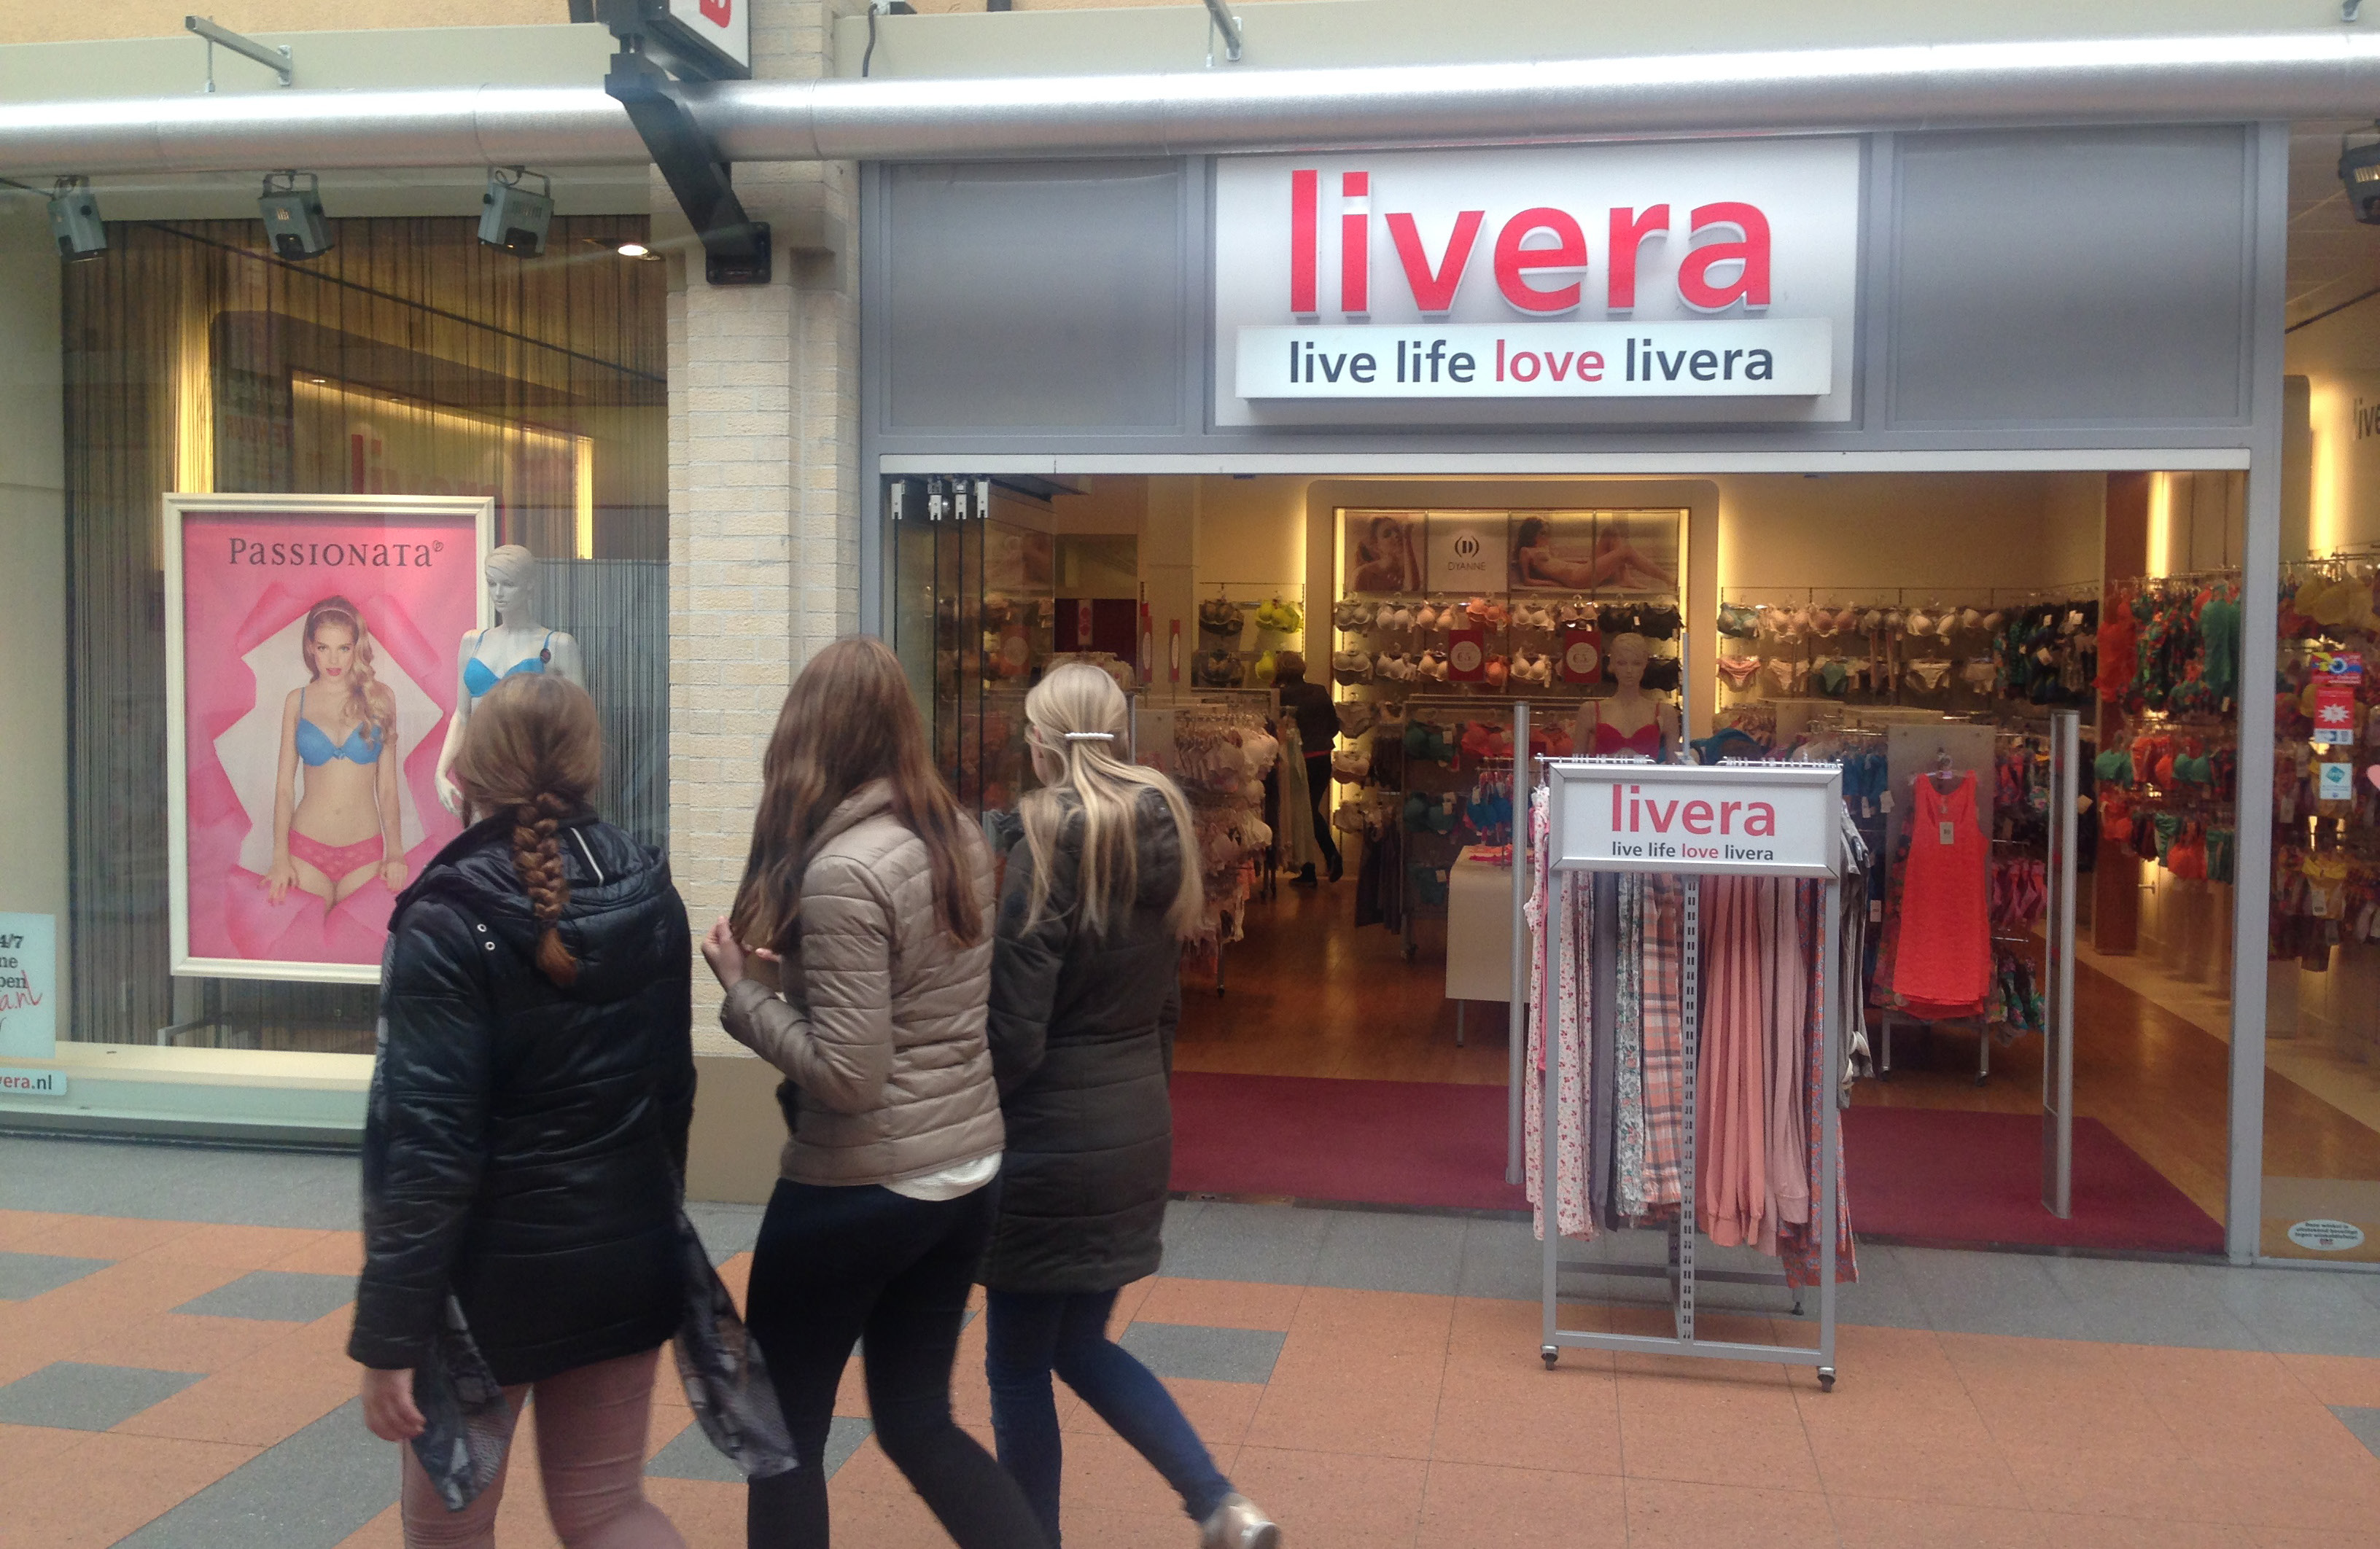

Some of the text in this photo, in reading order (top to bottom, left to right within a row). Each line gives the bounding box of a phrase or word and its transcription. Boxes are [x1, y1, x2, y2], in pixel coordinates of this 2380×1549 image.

[1291, 169, 1772, 314] livera
[1291, 338, 1773, 384] live life love livera
[1447, 561, 1486, 571] DYANNE
[1611, 784, 1776, 838] livera
[1612, 841, 1774, 862] live life love livera
[0, 1074, 52, 1090] era.nl
